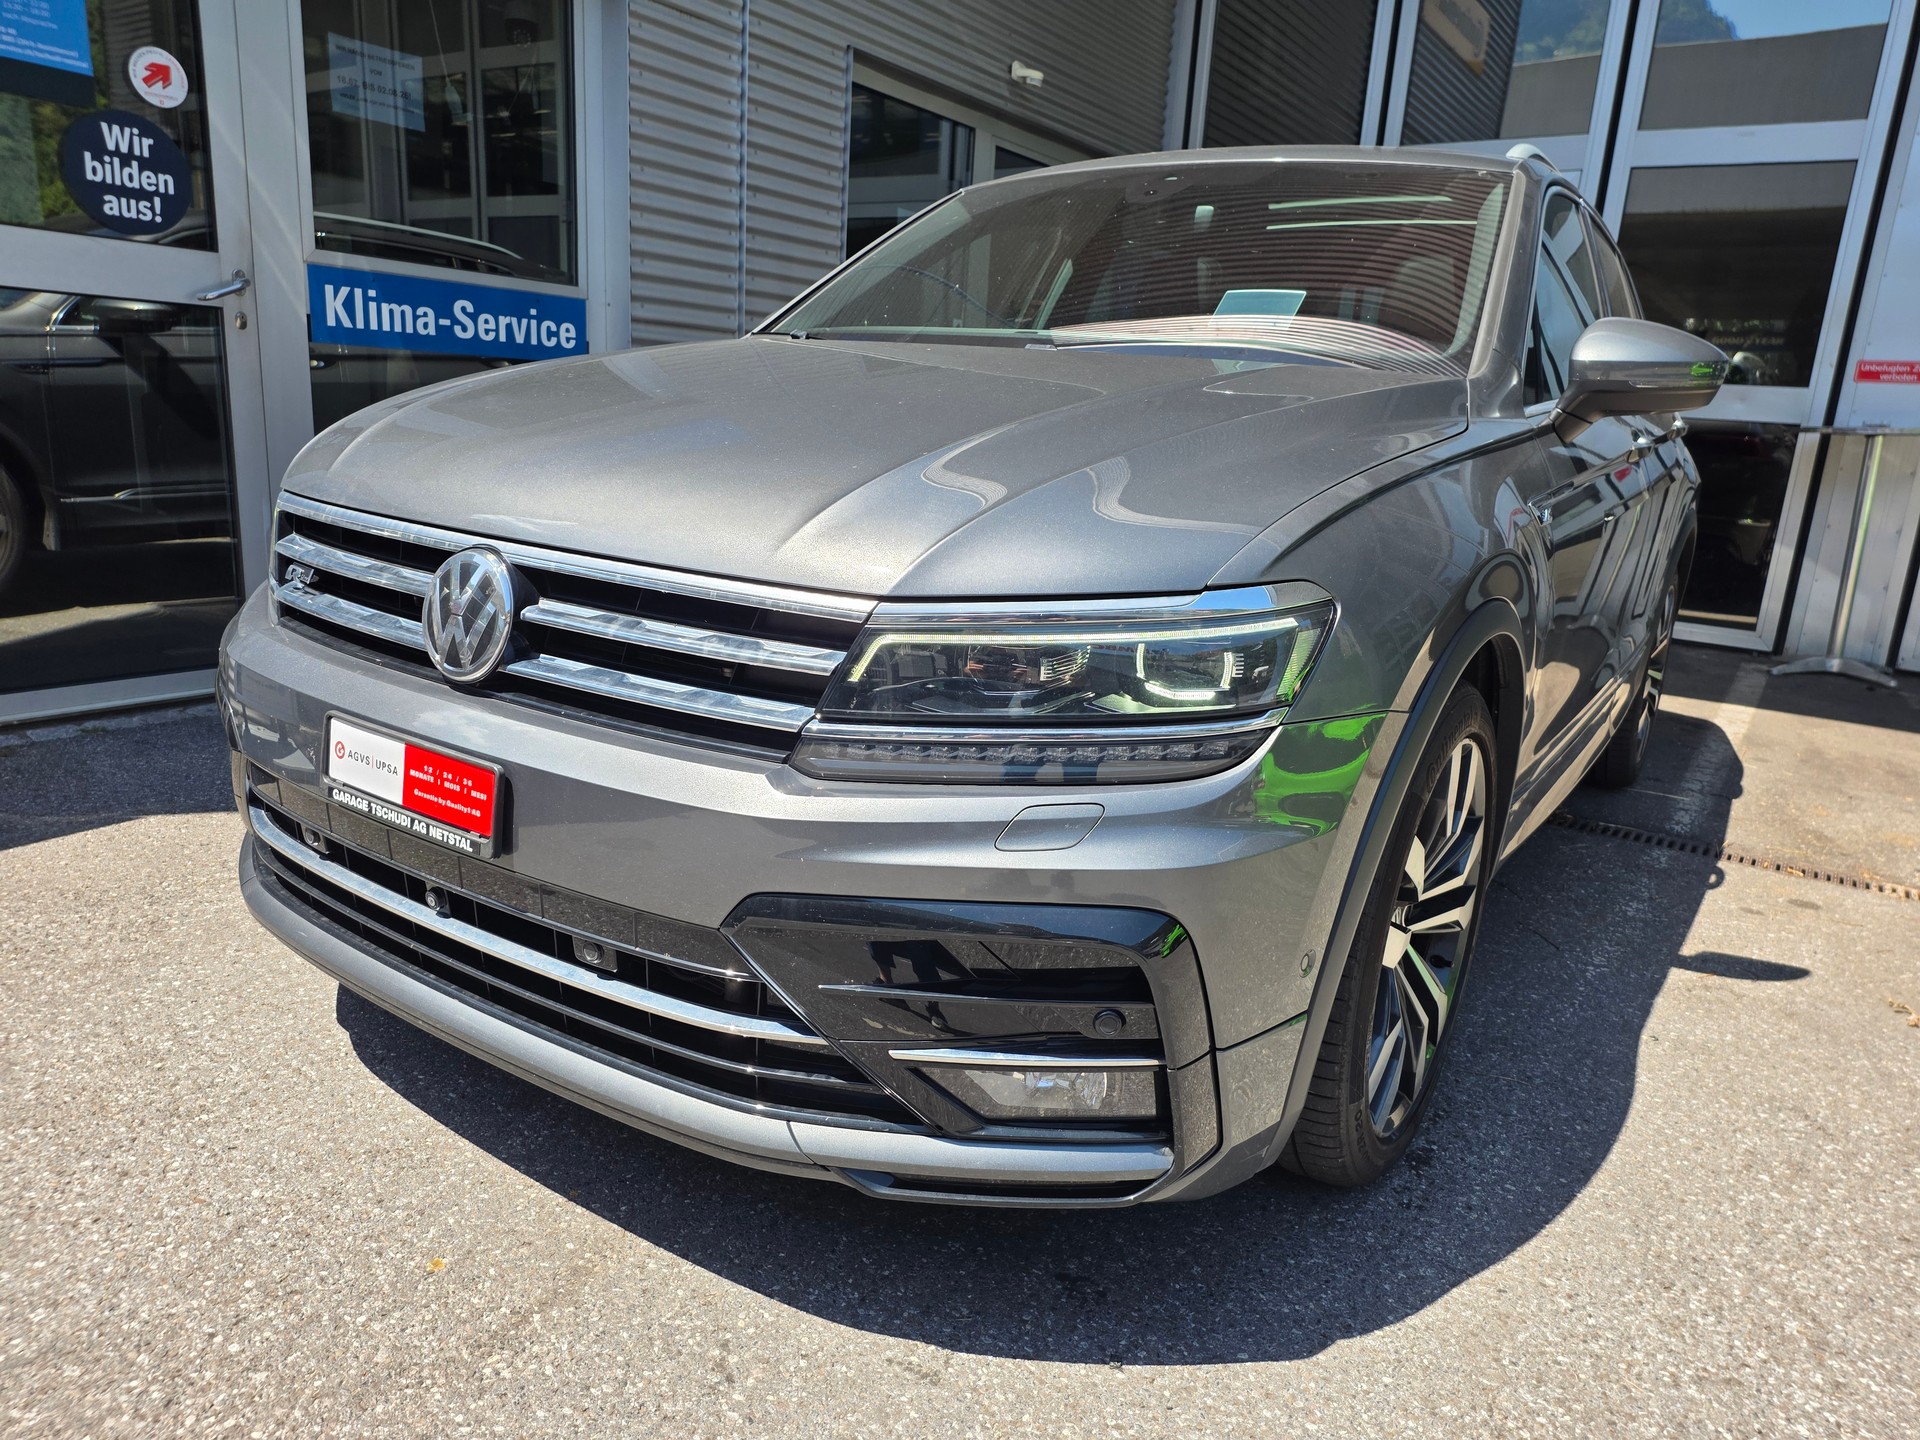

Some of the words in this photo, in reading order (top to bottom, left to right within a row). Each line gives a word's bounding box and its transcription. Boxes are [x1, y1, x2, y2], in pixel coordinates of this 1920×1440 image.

[100, 121, 154, 158] Wir
[84, 150, 175, 195] bilden
[103, 194, 162, 223] aus!
[324, 283, 577, 349] Klima-Service
[1861, 362, 1910, 373] Unbefugten
[1879, 373, 1917, 381] verboten
[347, 749, 371, 766] AGVS
[375, 758, 399, 776] UPSA
[424, 765, 433, 774] 12
[409, 768, 434, 783] MONATE
[443, 780, 460, 792] MOIS
[470, 790, 487, 801] MESI
[332, 788, 369, 812] GARAGE
[370, 802, 411, 828] TSCHUDI
[412, 820, 427, 834] AG
[428, 825, 474, 852] NETSTAL
[471, 809, 481, 817] AG
